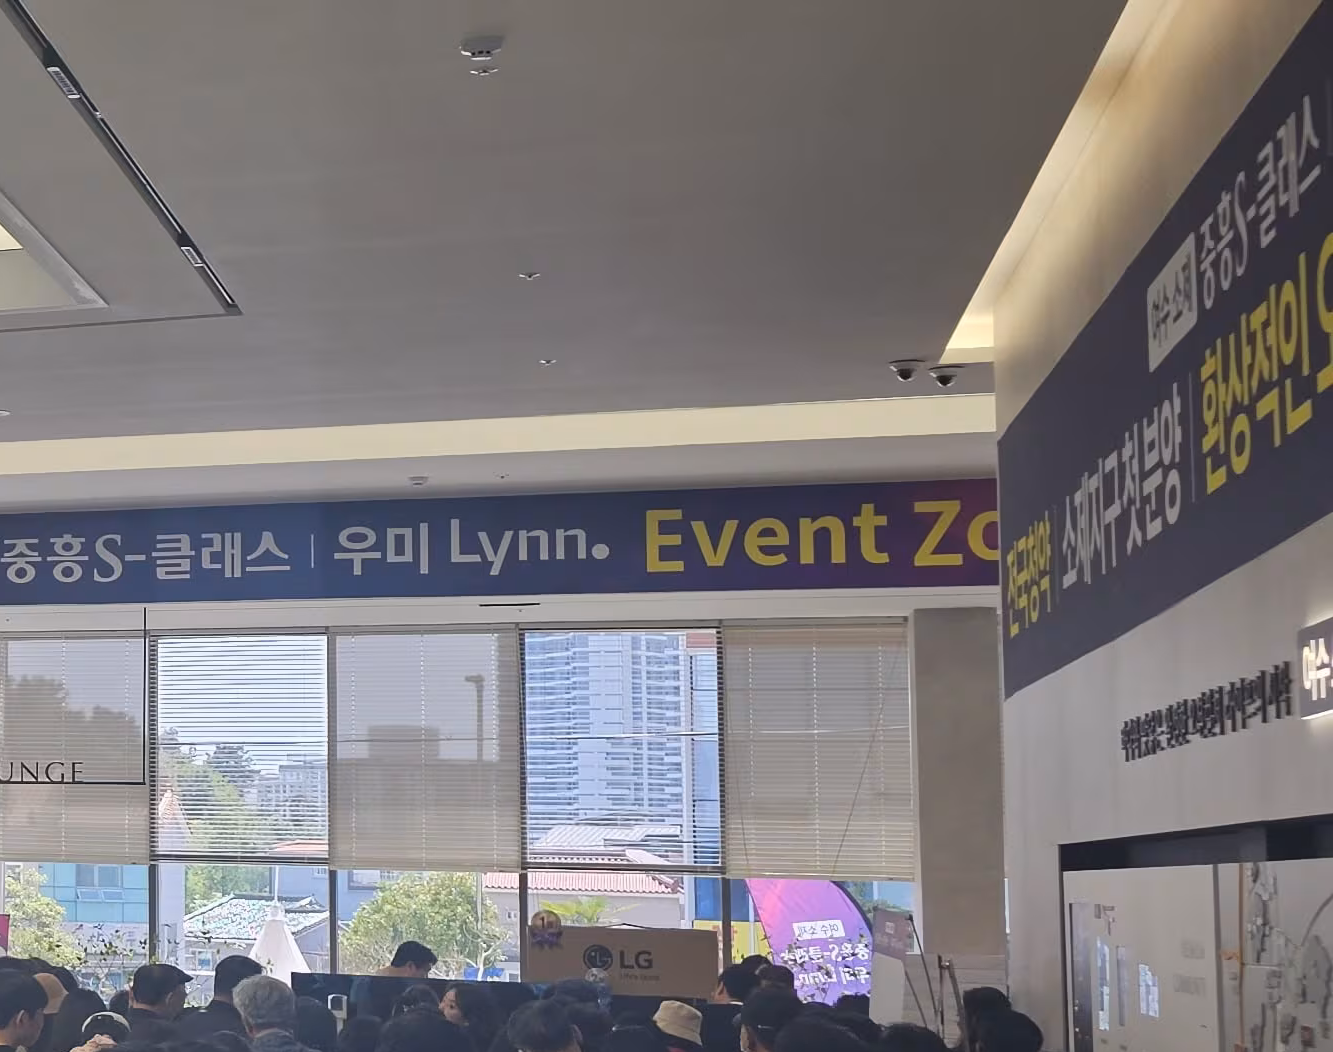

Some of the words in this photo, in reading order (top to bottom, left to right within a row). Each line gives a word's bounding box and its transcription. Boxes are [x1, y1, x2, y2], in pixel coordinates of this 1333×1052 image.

[1150, 278, 1171, 350] 여수
[1200, 96, 1321, 310] 중흥S-클래스
[1007, 510, 1051, 638] 전국청약
[1201, 251, 1313, 496] 환상적인
[0, 531, 291, 584] 중흥S-클래스
[333, 521, 429, 576] 우미
[645, 502, 890, 573] Event
[619, 949, 653, 970] LG
